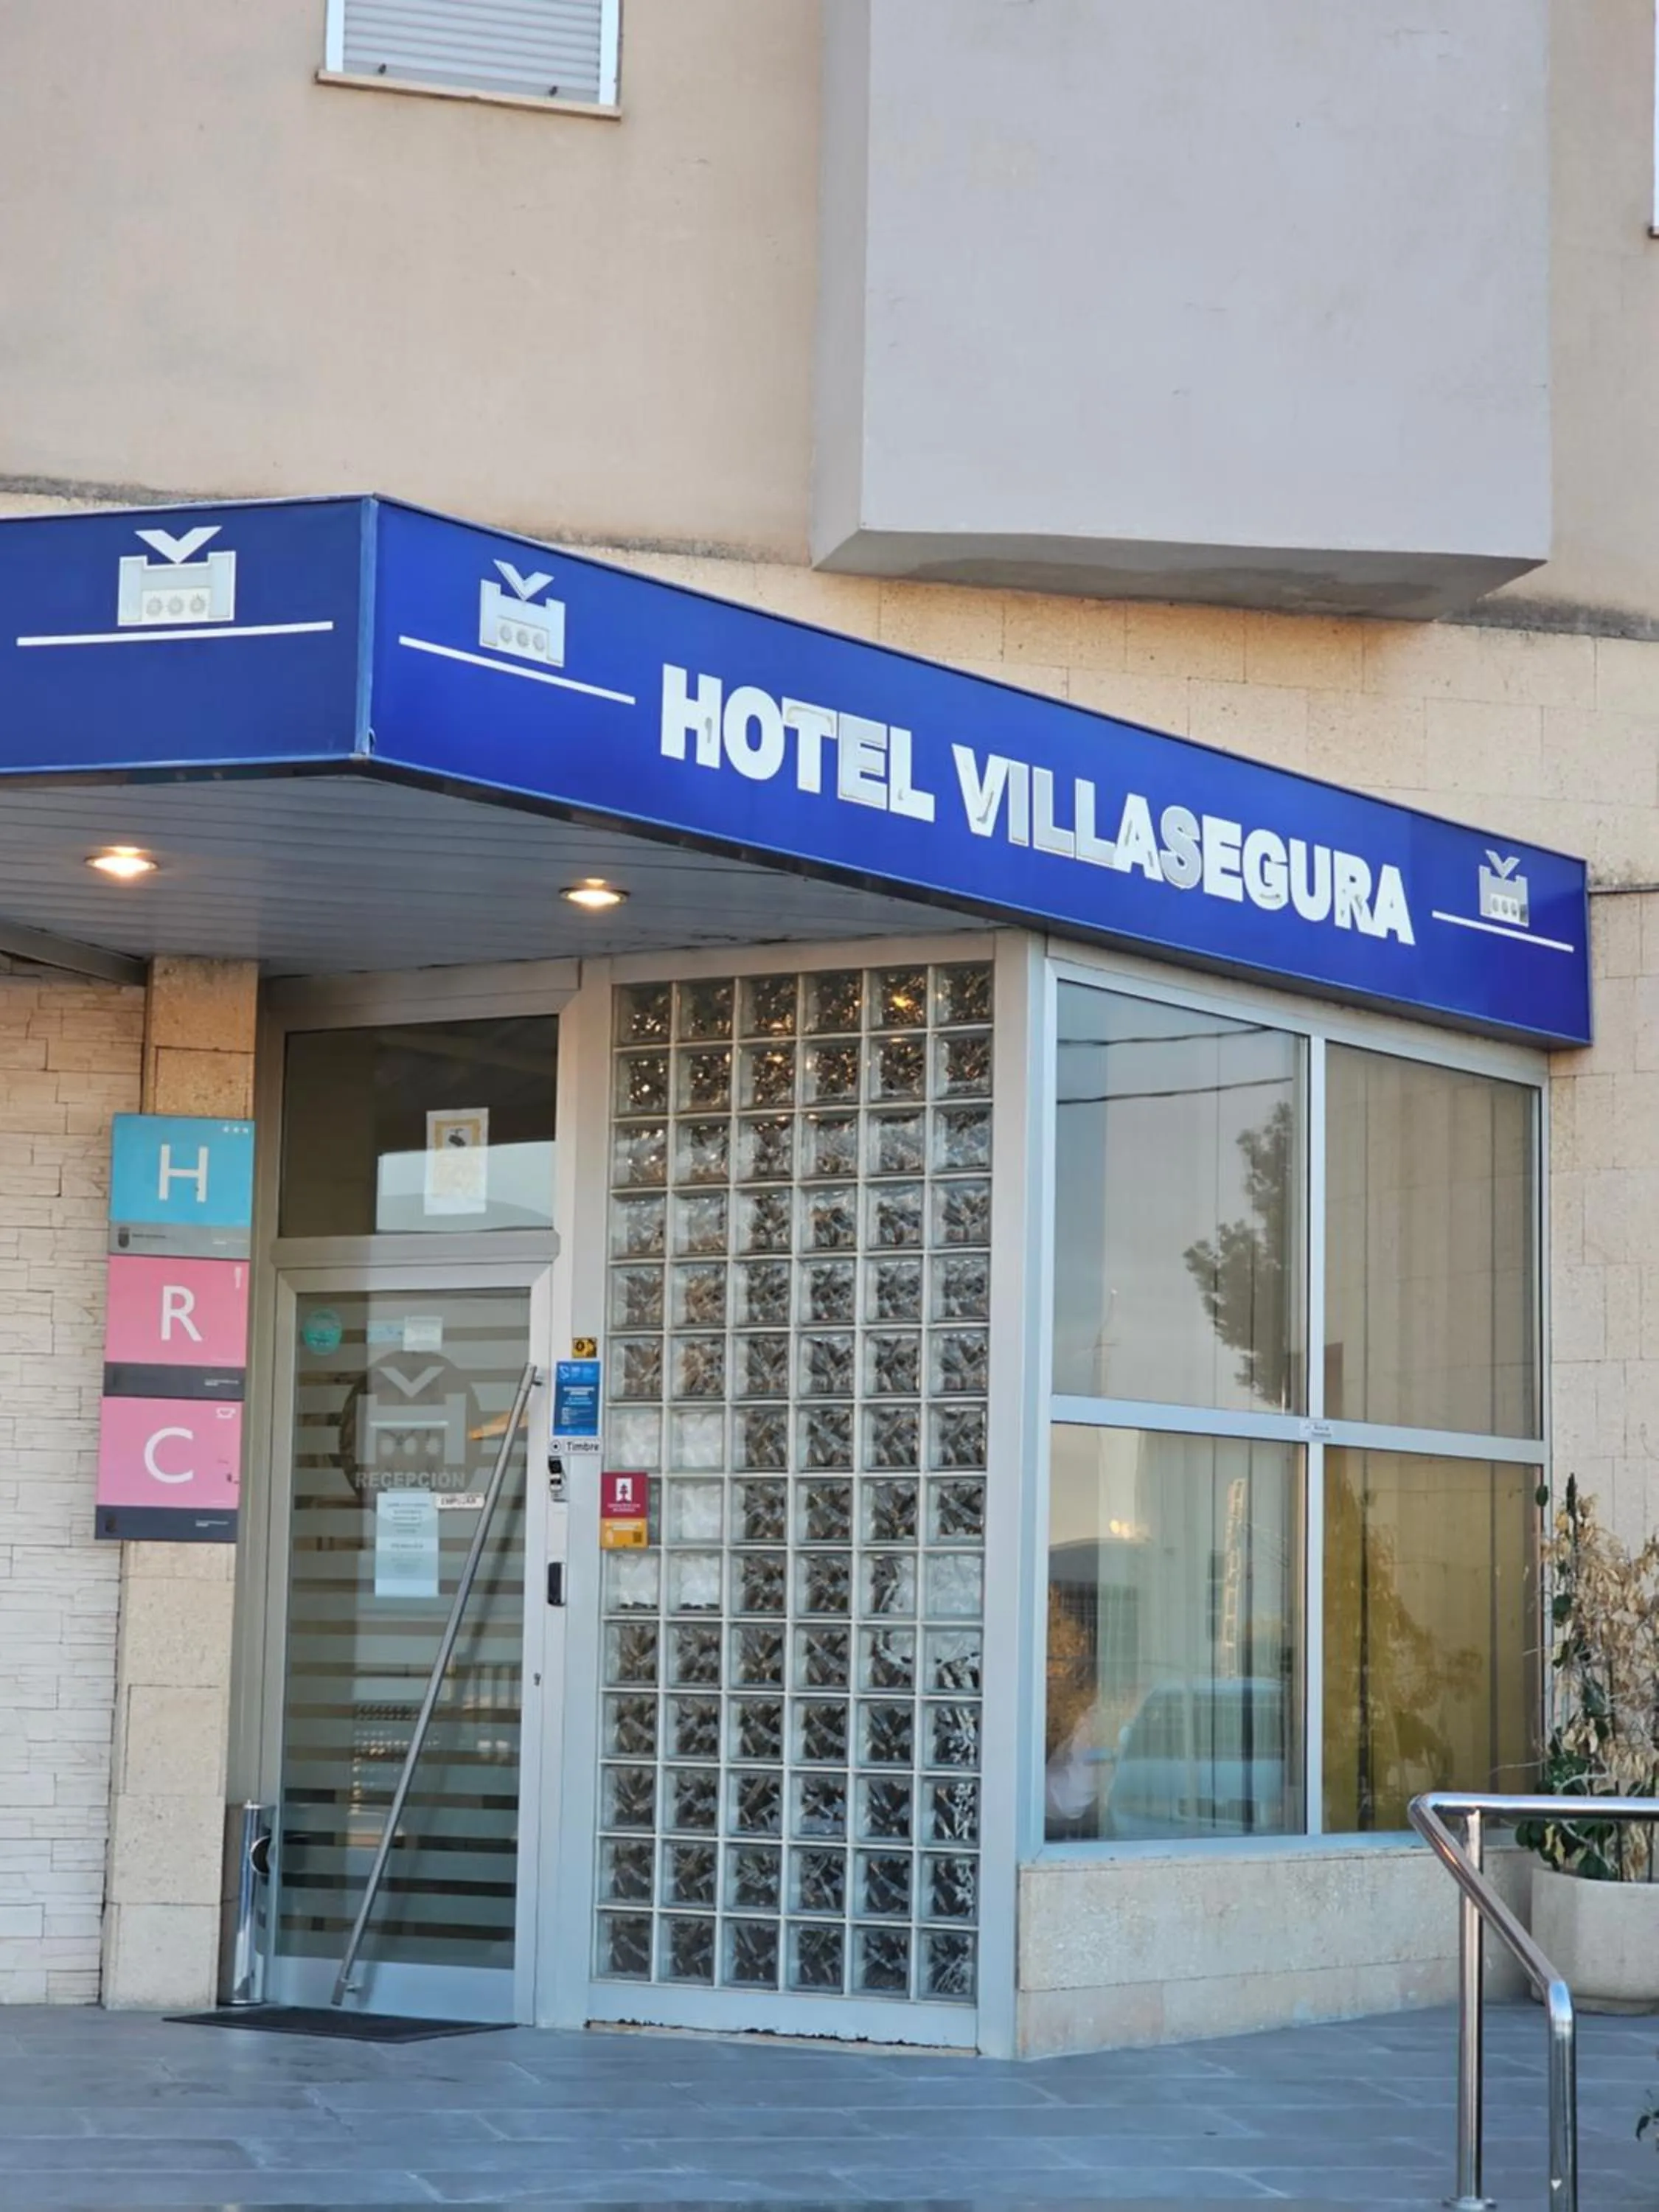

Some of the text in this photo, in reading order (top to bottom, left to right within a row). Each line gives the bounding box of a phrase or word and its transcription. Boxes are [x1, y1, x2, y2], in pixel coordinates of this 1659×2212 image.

[661, 664, 1416, 946] HOTEL VILLASEGURA
[159, 1144, 209, 1203] H
[160, 1285, 203, 1342] R
[145, 1427, 194, 1484] C
